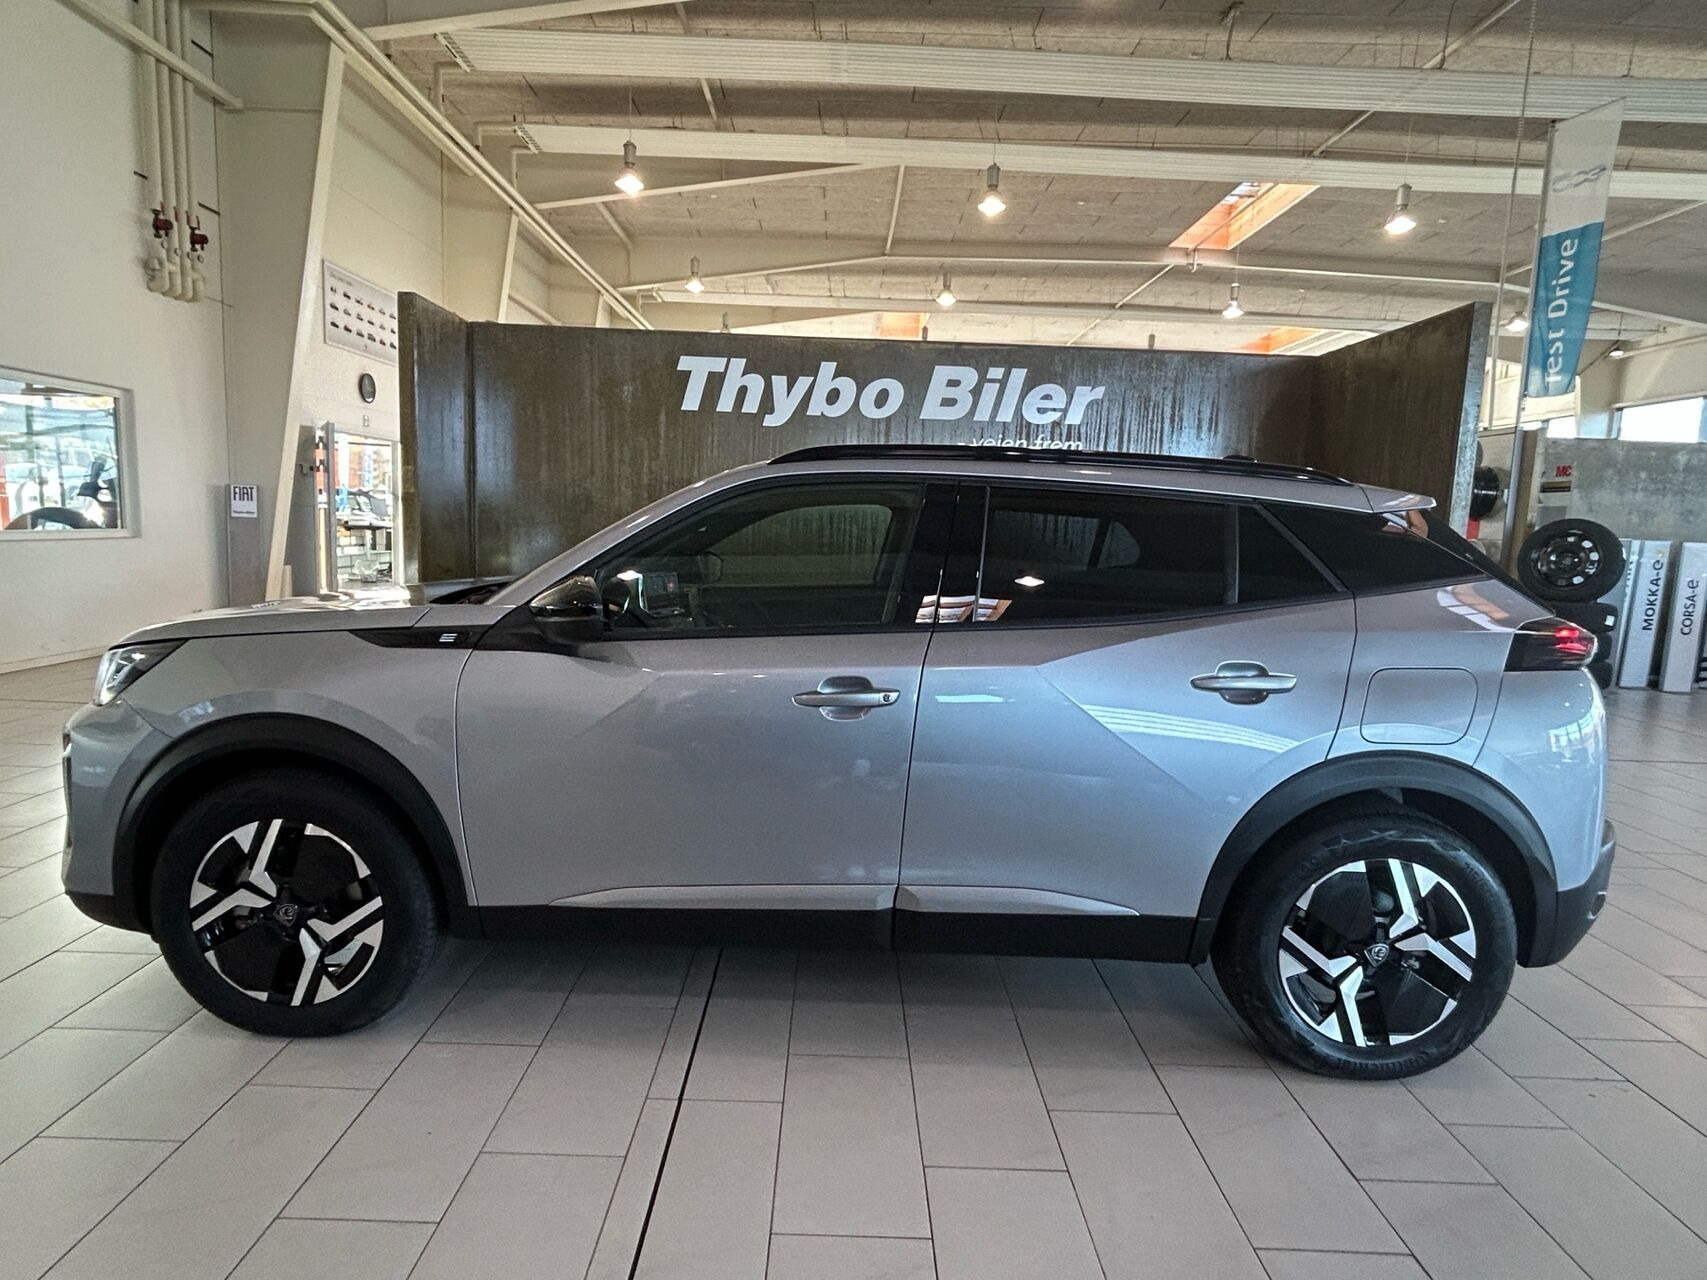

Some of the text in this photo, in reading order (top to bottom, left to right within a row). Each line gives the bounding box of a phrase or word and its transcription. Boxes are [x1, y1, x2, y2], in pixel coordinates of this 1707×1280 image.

[1544, 238, 1579, 384] Test Drive
[676, 355, 1106, 427] Thybo Biler
[233, 486, 255, 501] FIAT
[1642, 559, 1664, 631] MOKKA-e
[1680, 579, 1699, 636] CORSA-e
